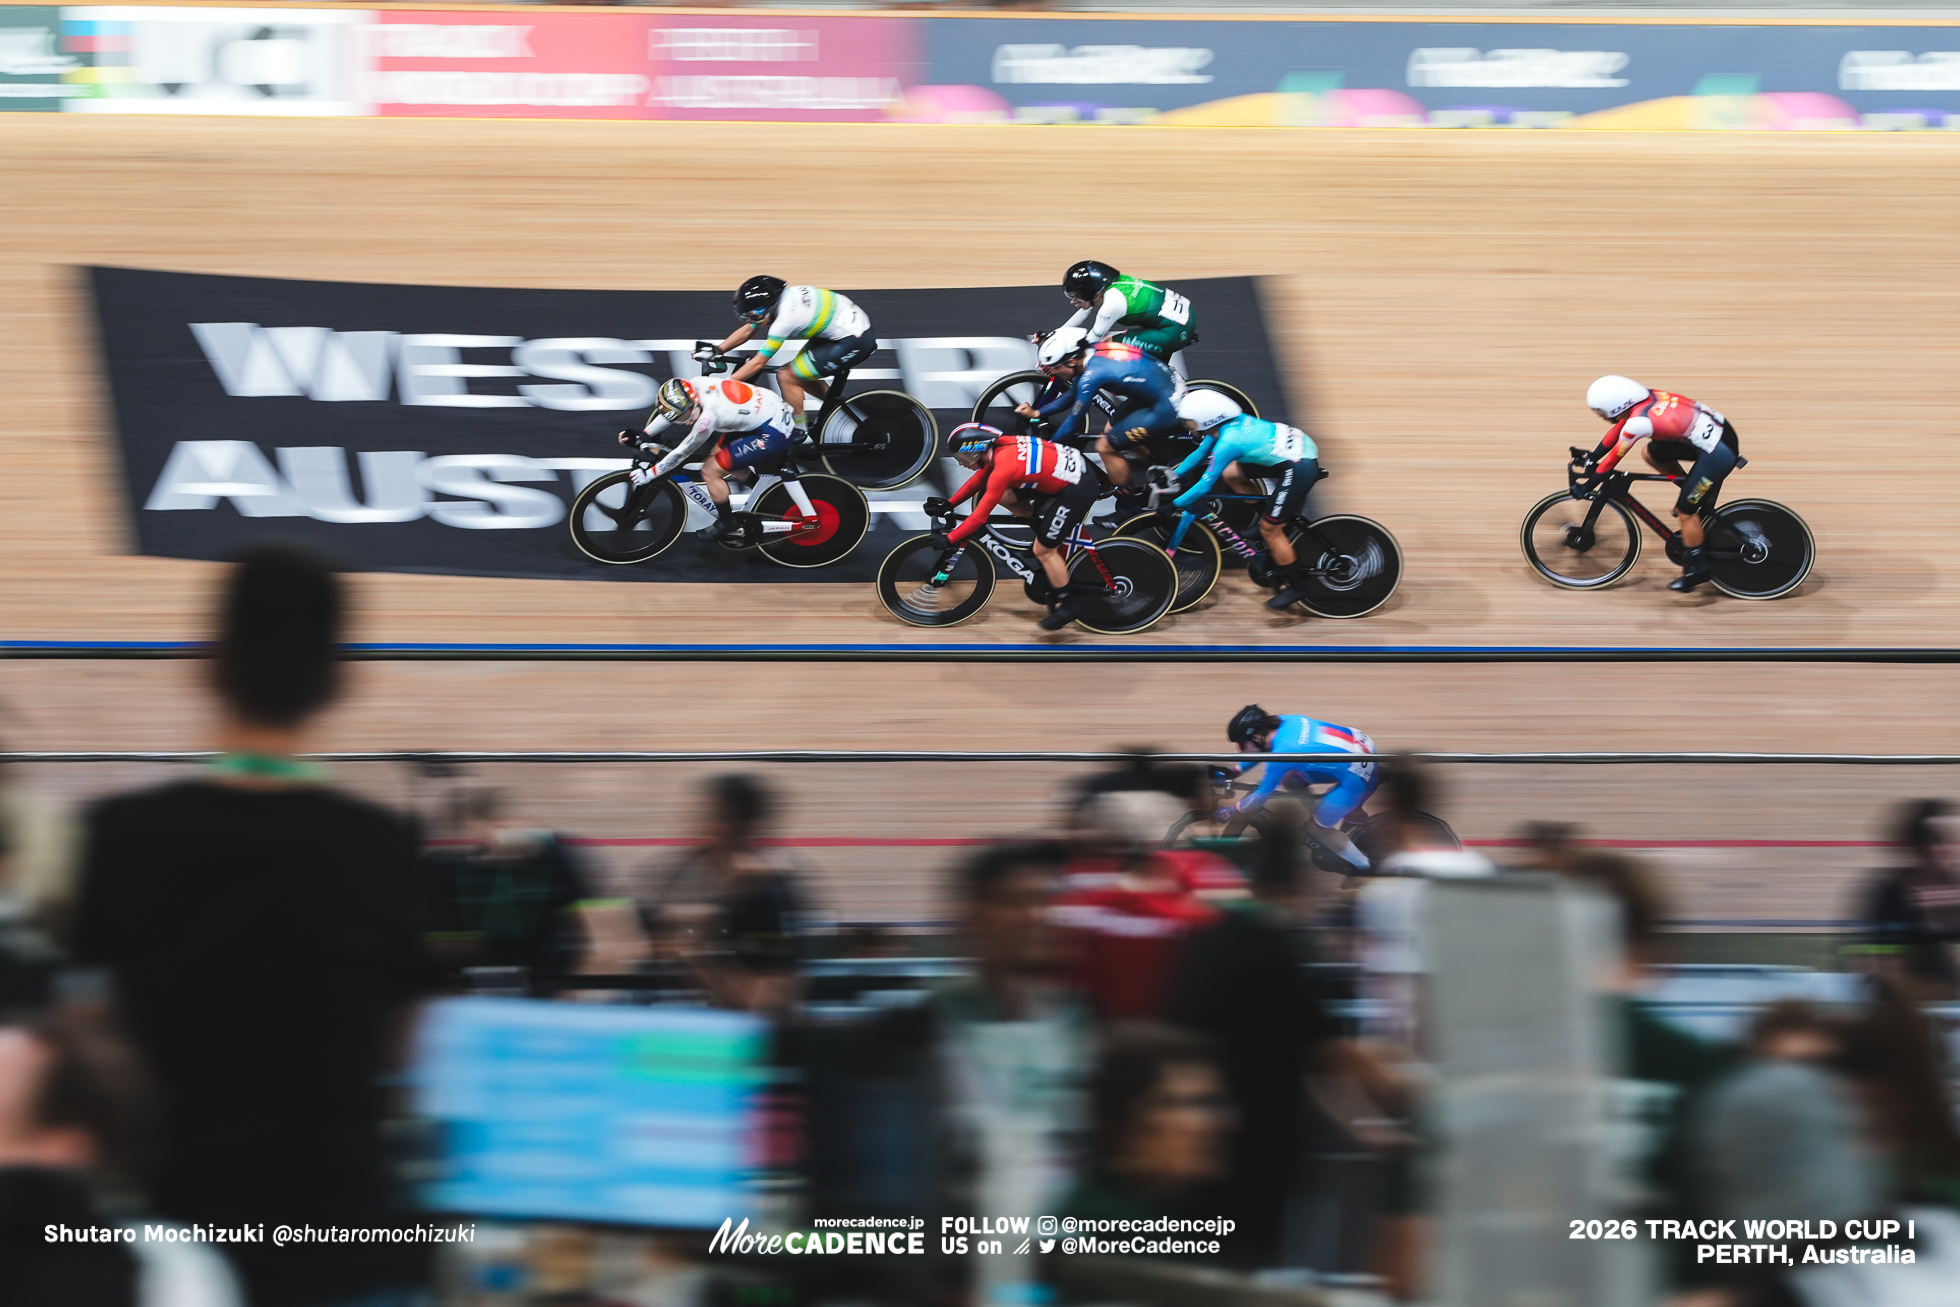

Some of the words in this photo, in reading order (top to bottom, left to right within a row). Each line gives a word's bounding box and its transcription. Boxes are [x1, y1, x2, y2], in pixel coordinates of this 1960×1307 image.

[1702, 423, 1714, 440] 3
[1046, 505, 1071, 540] NOR
[979, 533, 1035, 586] KOGA
